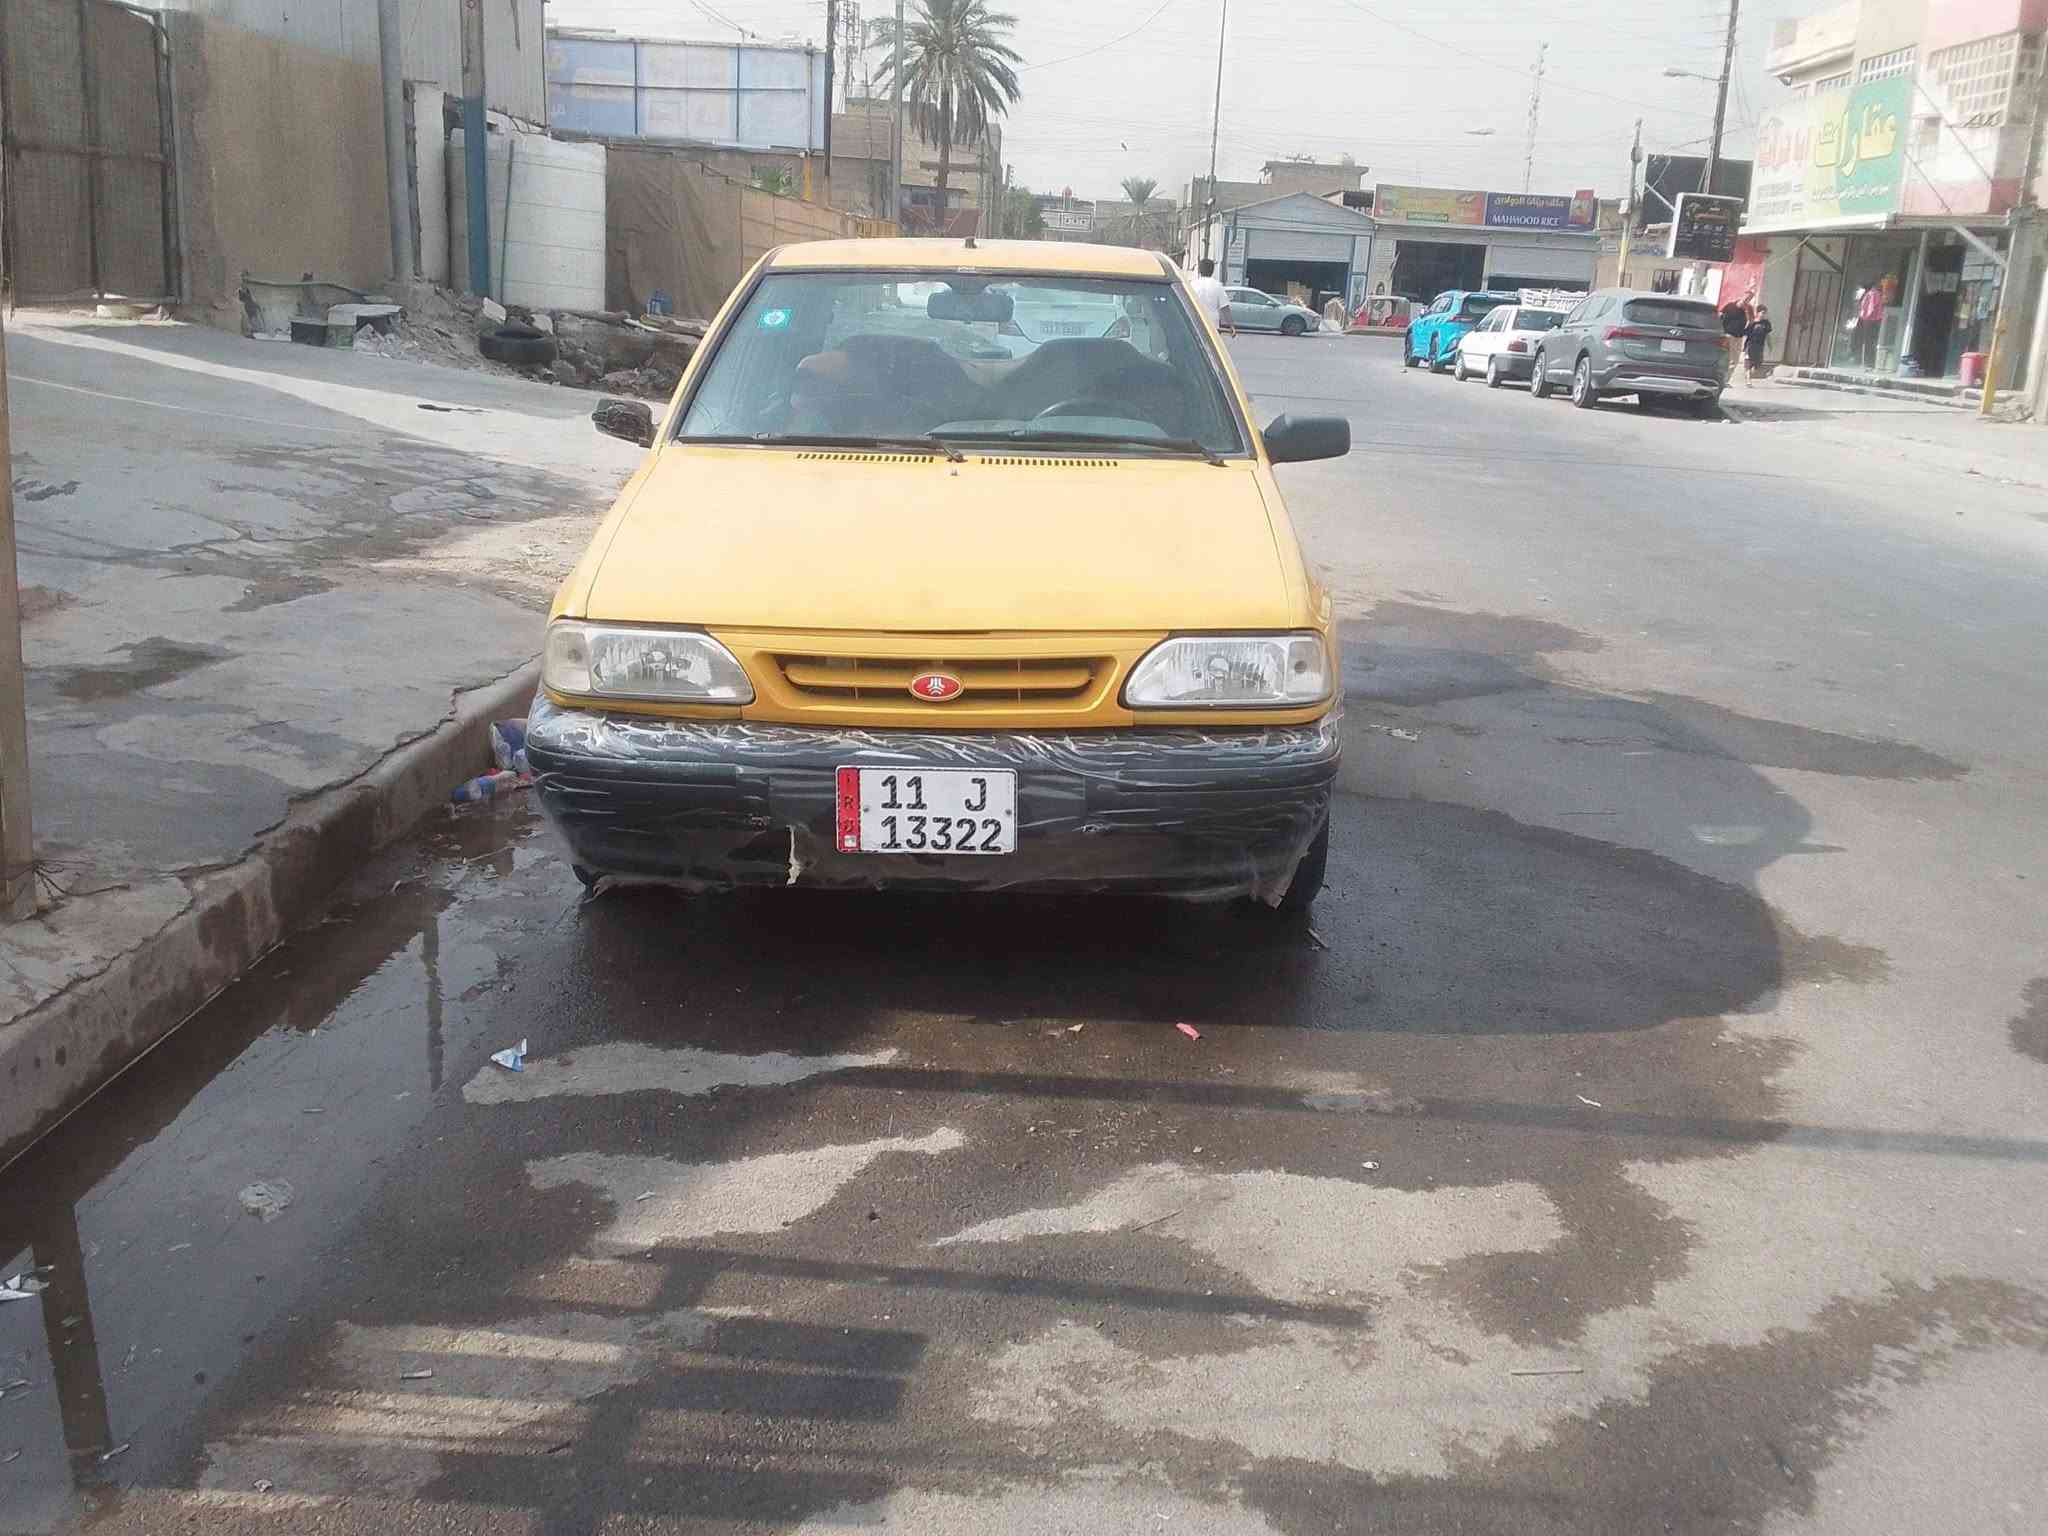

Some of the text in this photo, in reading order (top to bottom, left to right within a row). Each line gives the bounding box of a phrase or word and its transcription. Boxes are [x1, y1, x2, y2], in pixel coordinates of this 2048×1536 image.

[1815, 103, 1897, 177] عقارات
[1492, 214, 1560, 226] MAHMOOD RICE
[881, 775, 987, 812] 11 J
[881, 815, 1002, 852] 13322
